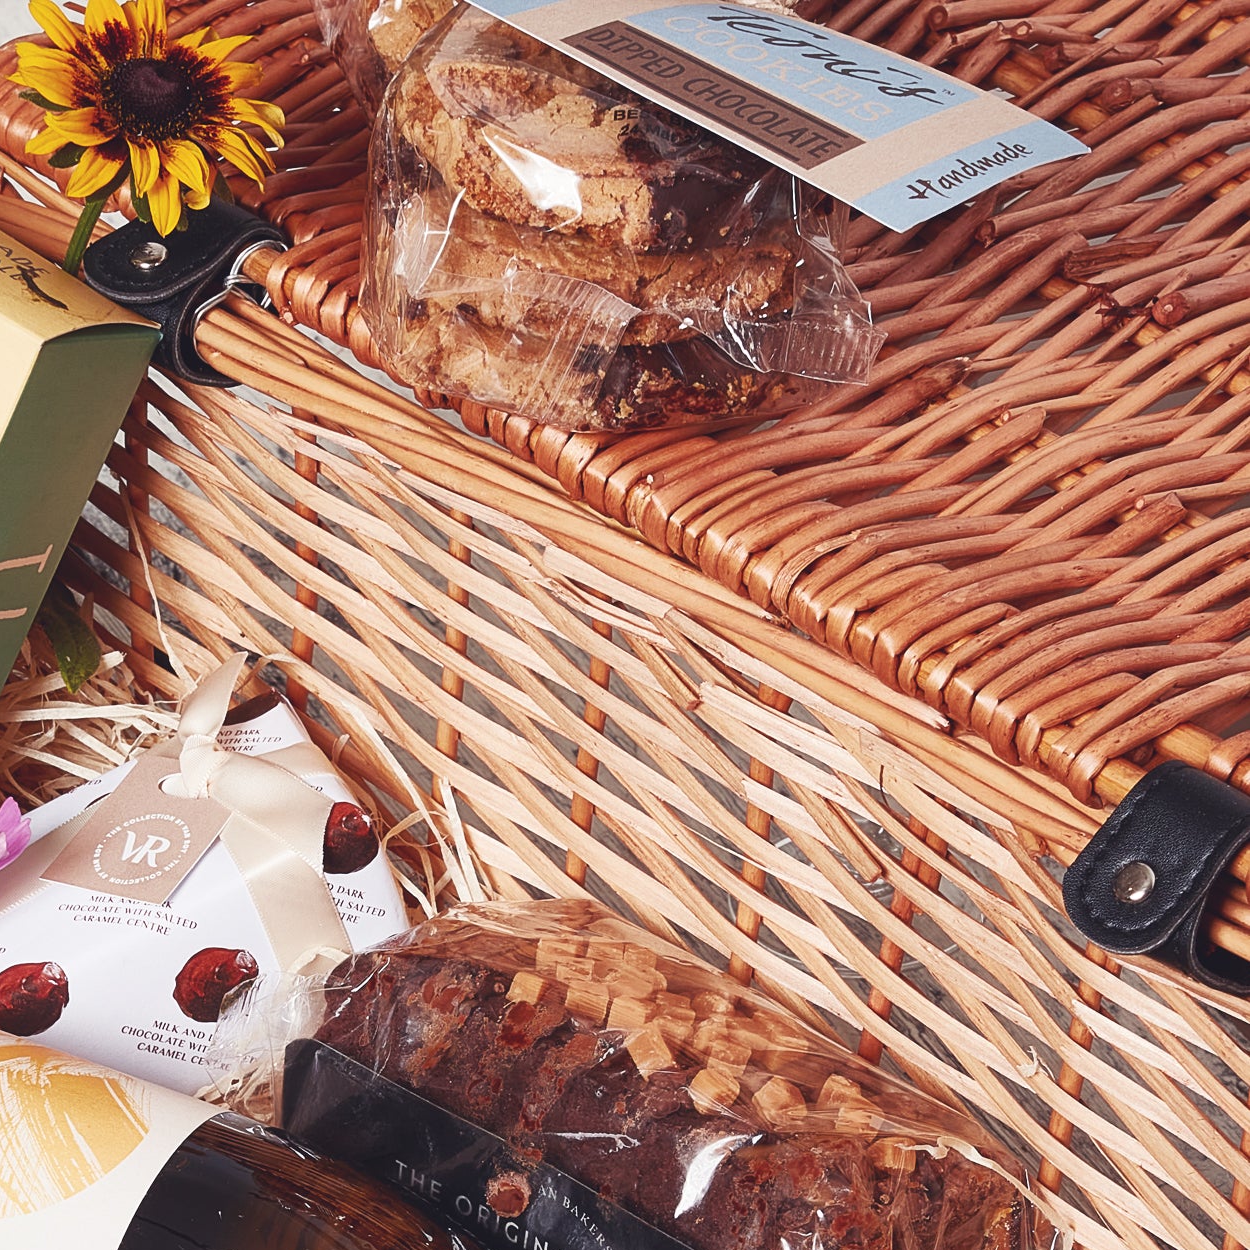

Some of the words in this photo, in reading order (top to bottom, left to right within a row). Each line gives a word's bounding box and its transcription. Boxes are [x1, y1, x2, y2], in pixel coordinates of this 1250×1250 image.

[706, 5, 945, 106] Teoni's
[663, 15, 894, 124] COOKIES
[585, 28, 685, 80] DIPPED
[683, 77, 843, 160] CHOCOLATE
[907, 142, 1034, 201] Handmade
[235, 729, 261, 737] DARK
[243, 736, 282, 744] SALTED
[105, 826, 122, 838] THE
[123, 813, 176, 827] COLLECTION
[121, 830, 171, 868] VR
[164, 860, 180, 872] THE
[109, 871, 162, 885] COLLECTION
[337, 885, 366, 900] DARK
[58, 903, 122, 914] CHOCOLATE
[125, 907, 152, 917] WITH
[155, 911, 198, 930] SALTED
[348, 901, 386, 918] SALTED
[73, 914, 122, 924] CARAMEL
[126, 918, 171, 936] CENTRE
[121, 1025, 186, 1048] CHOCOLATE
[152, 1020, 179, 1034] MILK
[181, 1028, 206, 1040] AND
[137, 1042, 187, 1062] CARAMEL
[396, 1160, 442, 1196] THE
